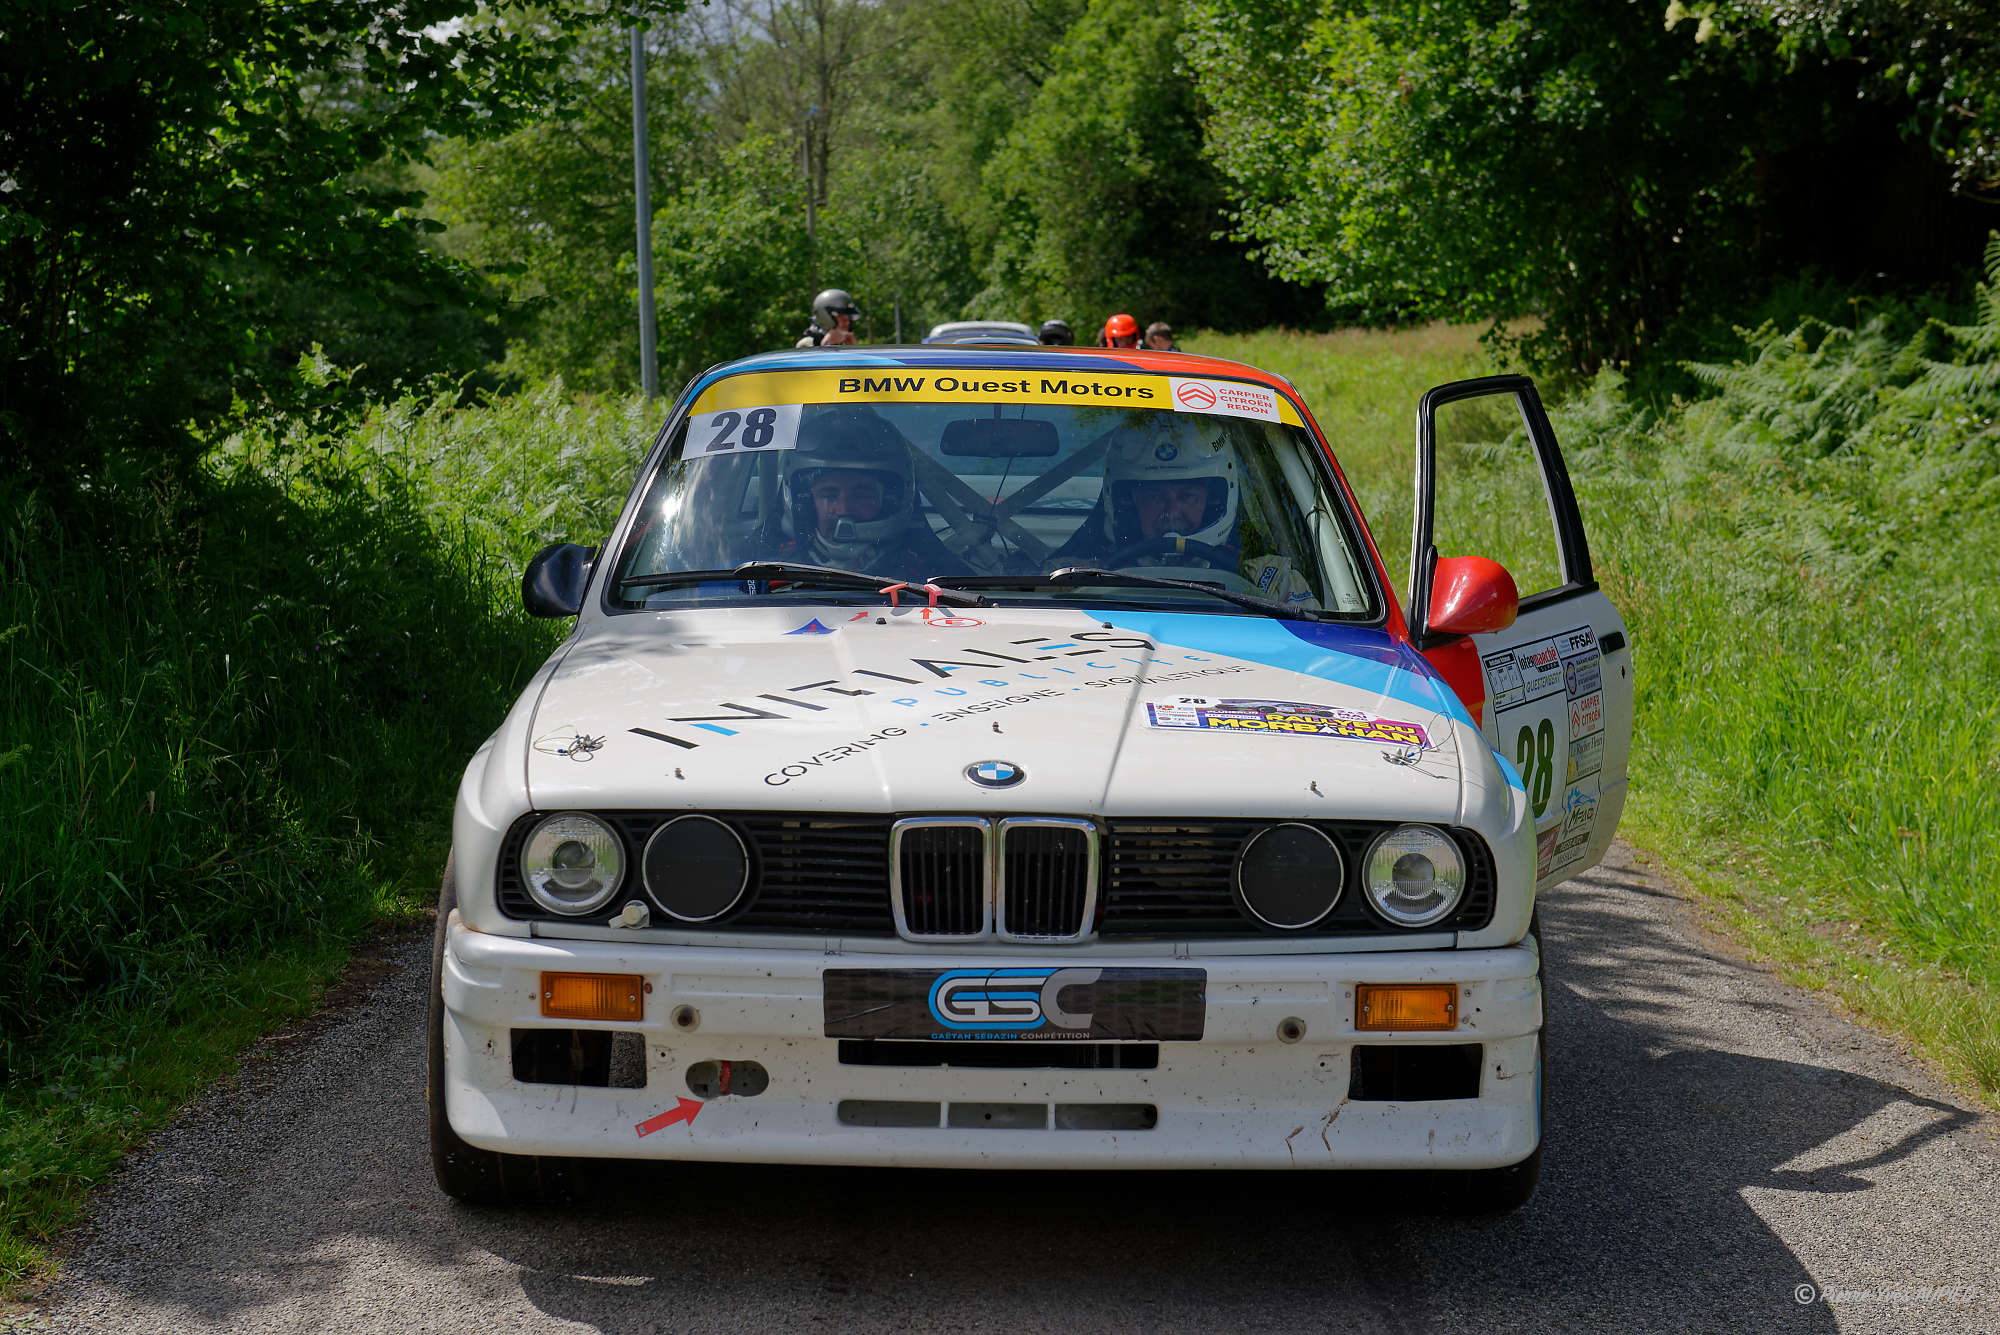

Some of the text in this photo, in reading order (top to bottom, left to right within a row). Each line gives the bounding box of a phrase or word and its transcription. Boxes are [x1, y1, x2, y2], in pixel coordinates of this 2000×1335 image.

[838, 377, 1155, 400] BMW Ouest Motors
[1219, 388, 1270, 401] CARPIER
[1220, 395, 1273, 409] CITROËN
[1226, 403, 1269, 415] REDON
[705, 408, 778, 453] 28
[1568, 632, 1591, 651] FFSA
[626, 631, 1155, 750] INITIALES
[1178, 697, 1207, 705] 28
[1265, 713, 1372, 729] RALLYE
[1375, 723, 1417, 734] DU
[764, 726, 907, 787] COVERING
[930, 688, 1066, 722] ENSEIGNE
[1516, 717, 1555, 819] 28
[928, 967, 1104, 1031] GSC
[1020, 1031, 1091, 1041] COMPÉTITION
